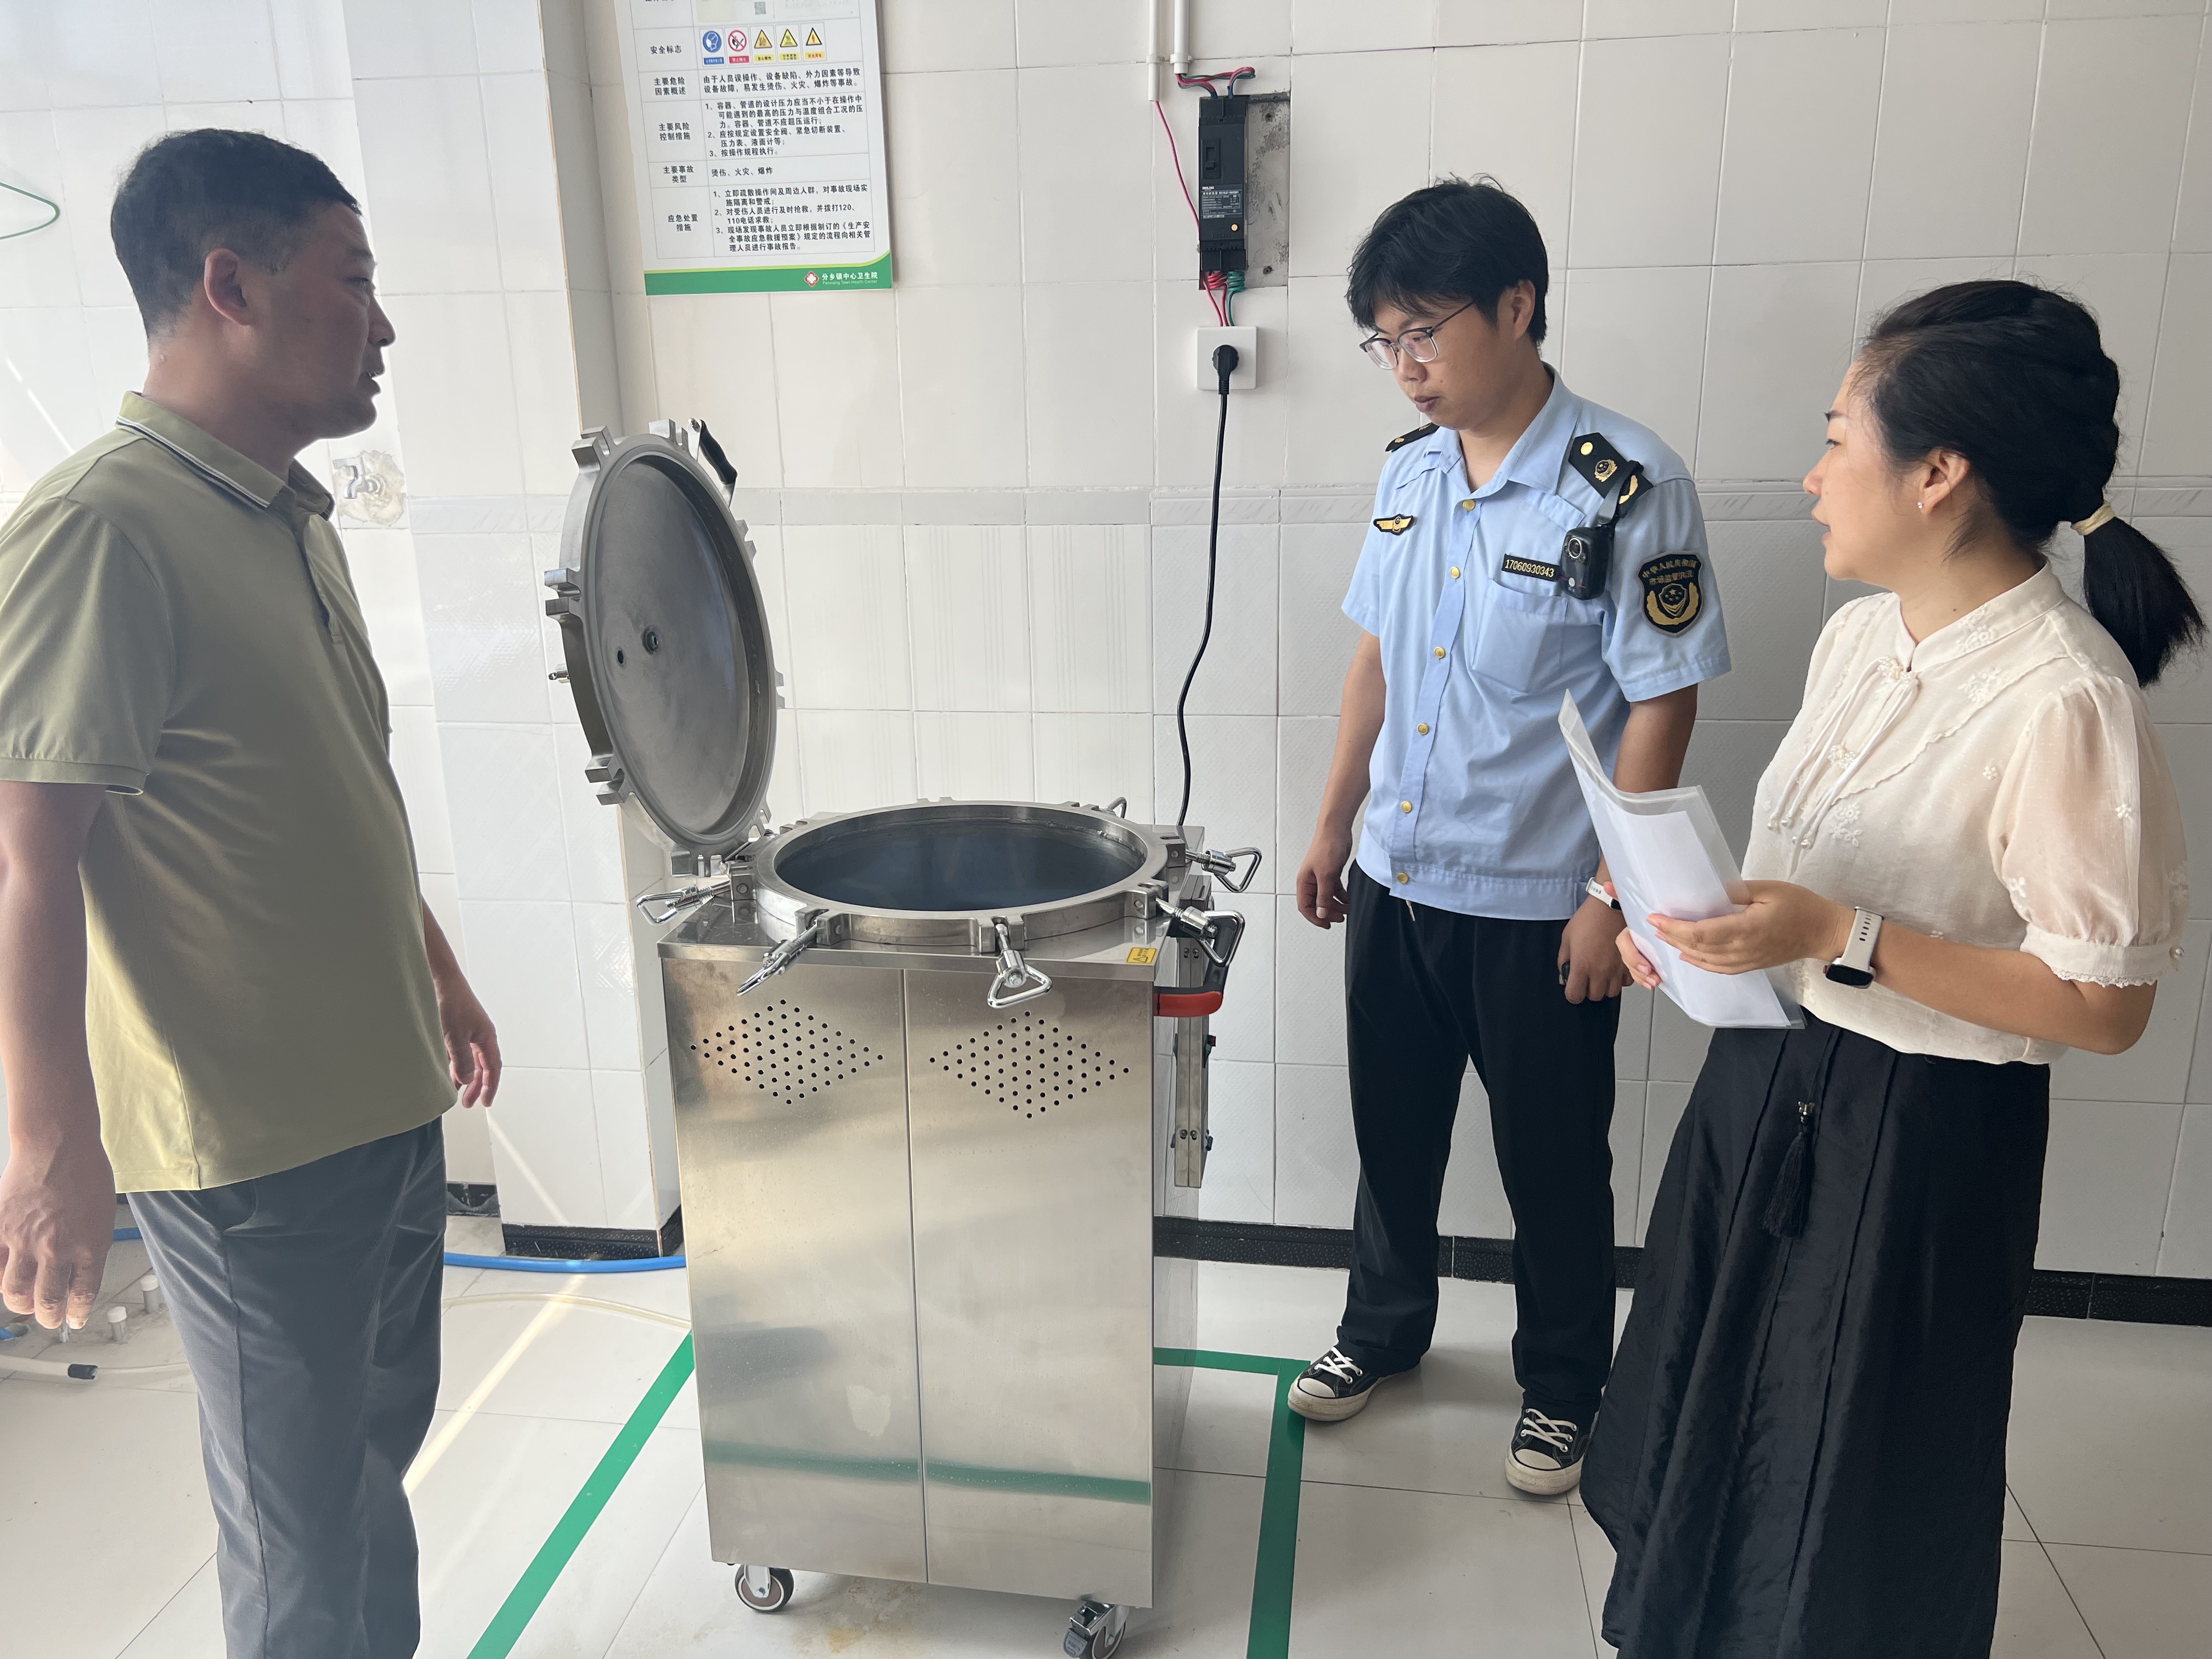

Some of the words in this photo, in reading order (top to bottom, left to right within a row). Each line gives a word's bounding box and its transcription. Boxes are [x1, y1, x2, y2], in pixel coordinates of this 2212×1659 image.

[650, 46, 682, 54] 安全标志
[703, 67, 860, 83] 由于人员误操作、设备缺陷、外力因素等导致
[653, 77, 685, 86] 主要危险
[654, 87, 686, 95] 因素概述
[719, 105, 863, 119] 可能遇到的最高的压力与温度组合工况的压
[659, 123, 690, 132] 主要风险
[660, 133, 691, 141] 控制措施
[663, 166, 693, 174] 主要事故
[712, 167, 773, 177] 烫伤、火灾、爆炸
[668, 215, 698, 223] 应急处置
[676, 224, 691, 232] 措施
[729, 231, 871, 242] 全事故应急救援预案》规定的流程向相关管
[730, 243, 800, 251] 理人员进行事故报告。
[822, 272, 878, 280] 分乡镇中心卫生院
[1505, 559, 1554, 577] 17060930343
